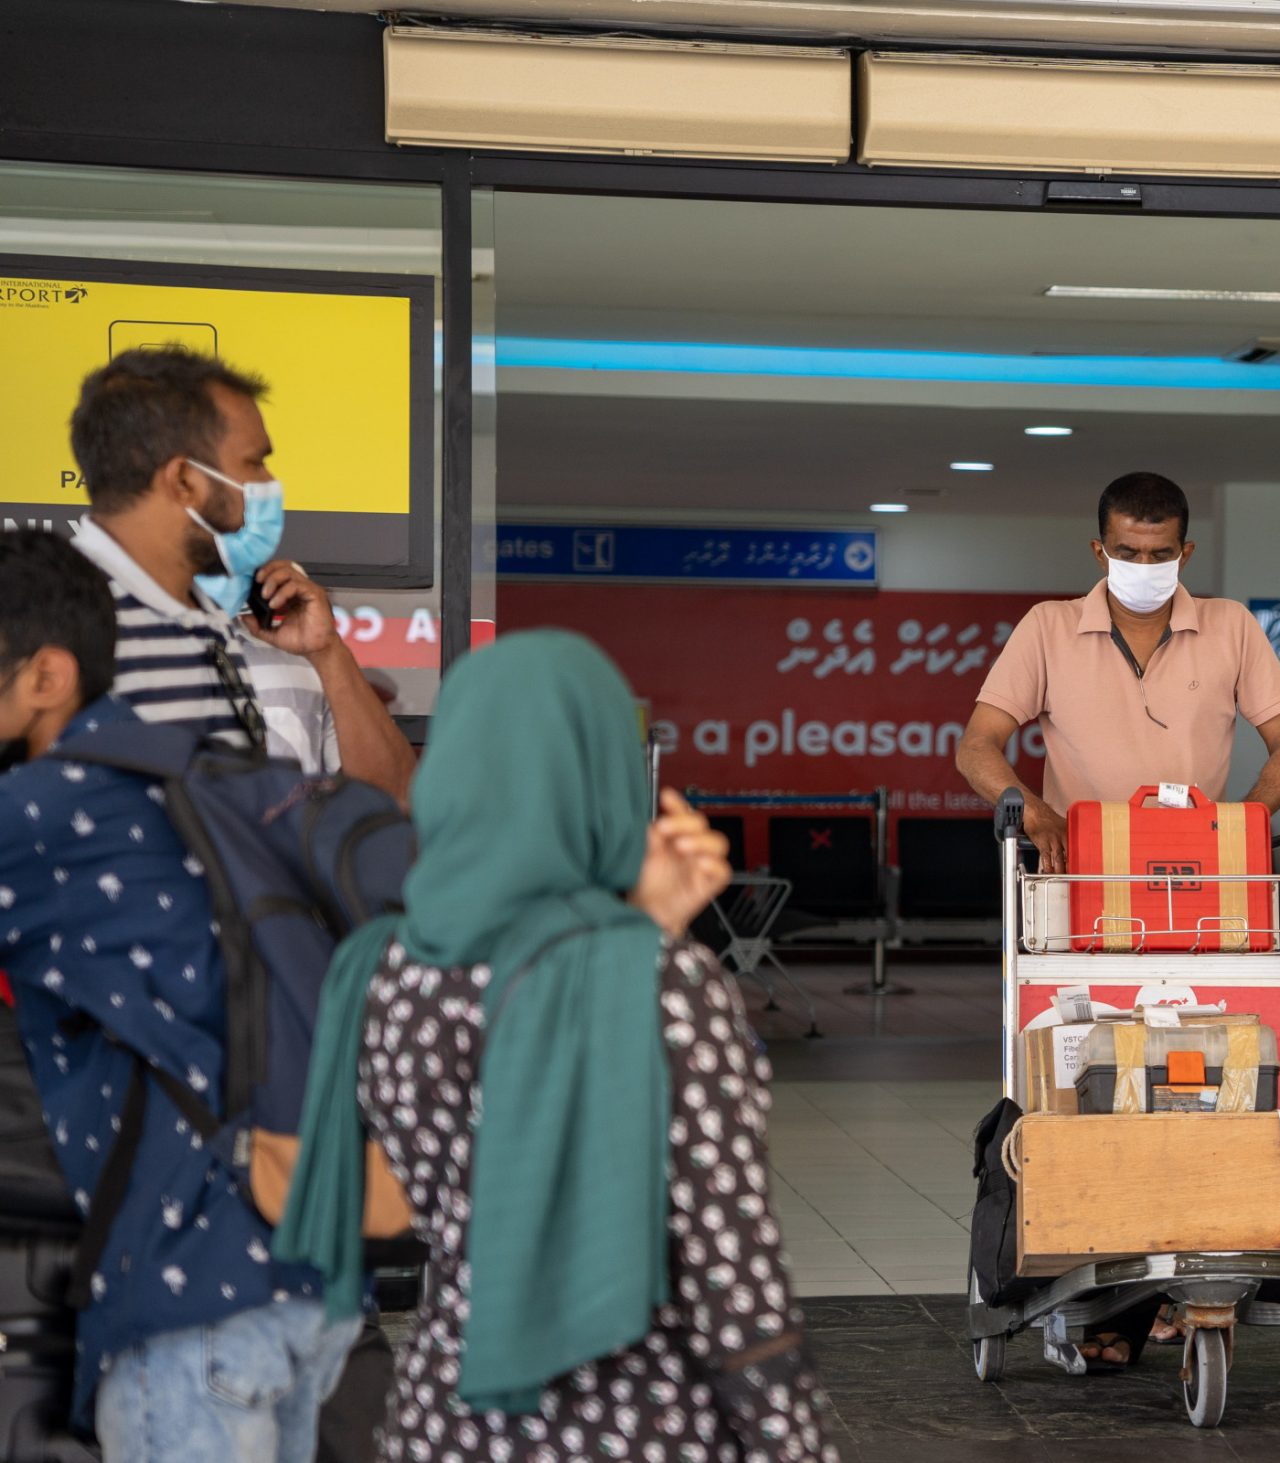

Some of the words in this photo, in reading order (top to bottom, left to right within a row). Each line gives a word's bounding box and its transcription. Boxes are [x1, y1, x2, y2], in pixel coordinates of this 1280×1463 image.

[693, 719, 729, 755] a
[744, 707, 963, 768] pleasan
[908, 788, 938, 810] the
